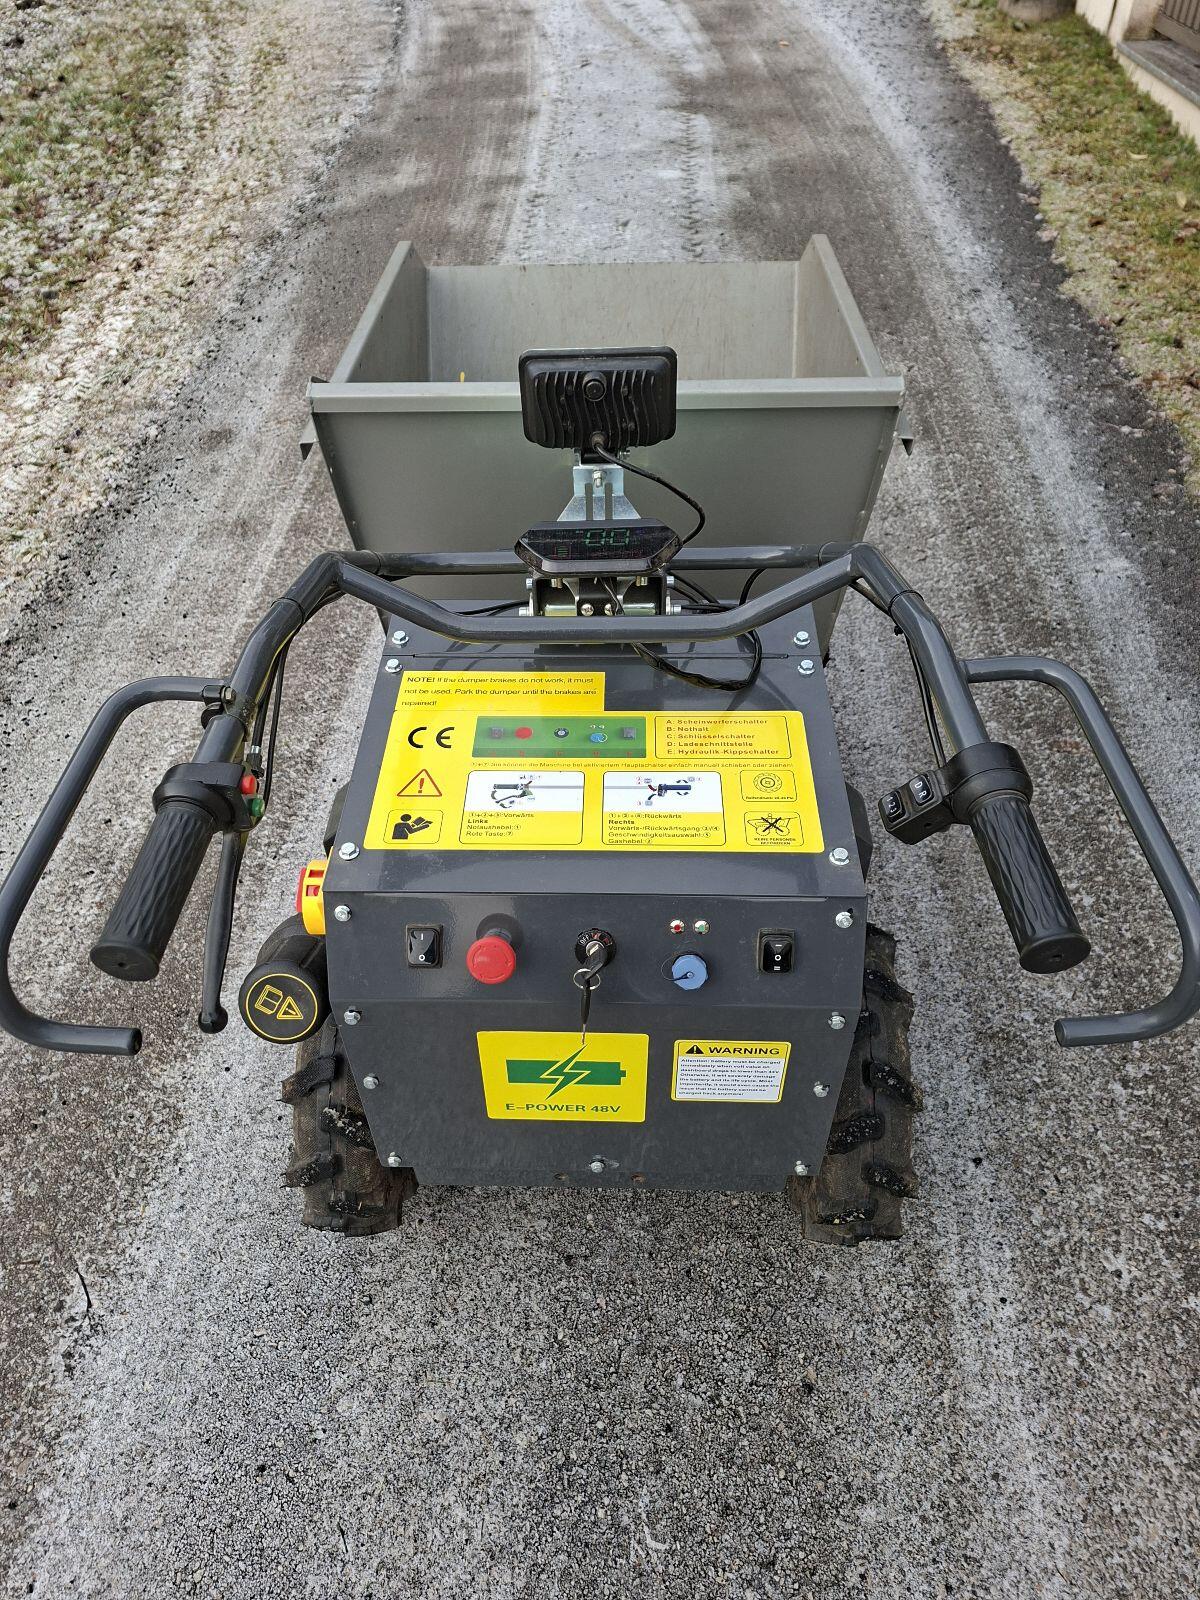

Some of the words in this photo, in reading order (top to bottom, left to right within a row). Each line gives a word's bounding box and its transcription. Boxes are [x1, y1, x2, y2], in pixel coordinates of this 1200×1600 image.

[408, 726, 455, 749] CE
[914, 781, 923, 789] D
[918, 790, 927, 798] R
[579, 934, 590, 945] OFF
[708, 1046, 780, 1055] WARNING
[505, 1103, 586, 1112] E-POWER
[590, 1105, 621, 1113] 48V
